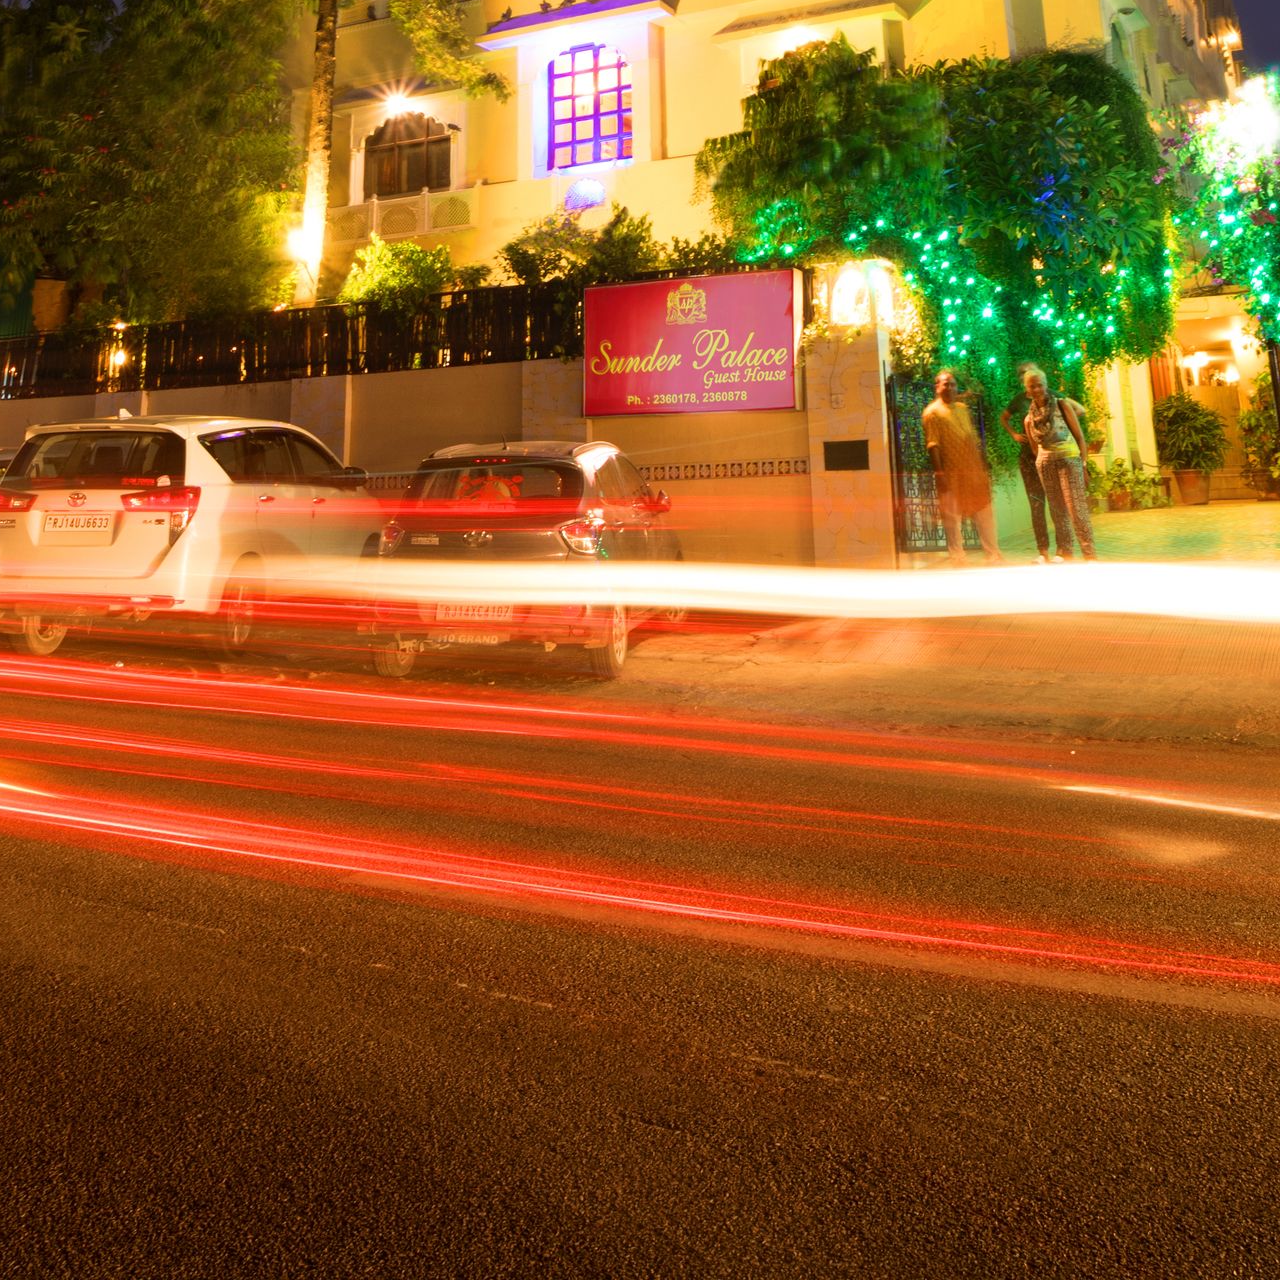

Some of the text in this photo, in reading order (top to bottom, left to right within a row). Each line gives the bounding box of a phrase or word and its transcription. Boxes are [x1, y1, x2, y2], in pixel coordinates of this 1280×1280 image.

[591, 329, 788, 375] Sunder Palace
[703, 368, 786, 389] Guest House
[653, 393, 699, 405] 2360178,
[702, 391, 747, 403] 2360878
[52, 517, 109, 529] RJ14UJ6633
[458, 634, 499, 645] GRAND
